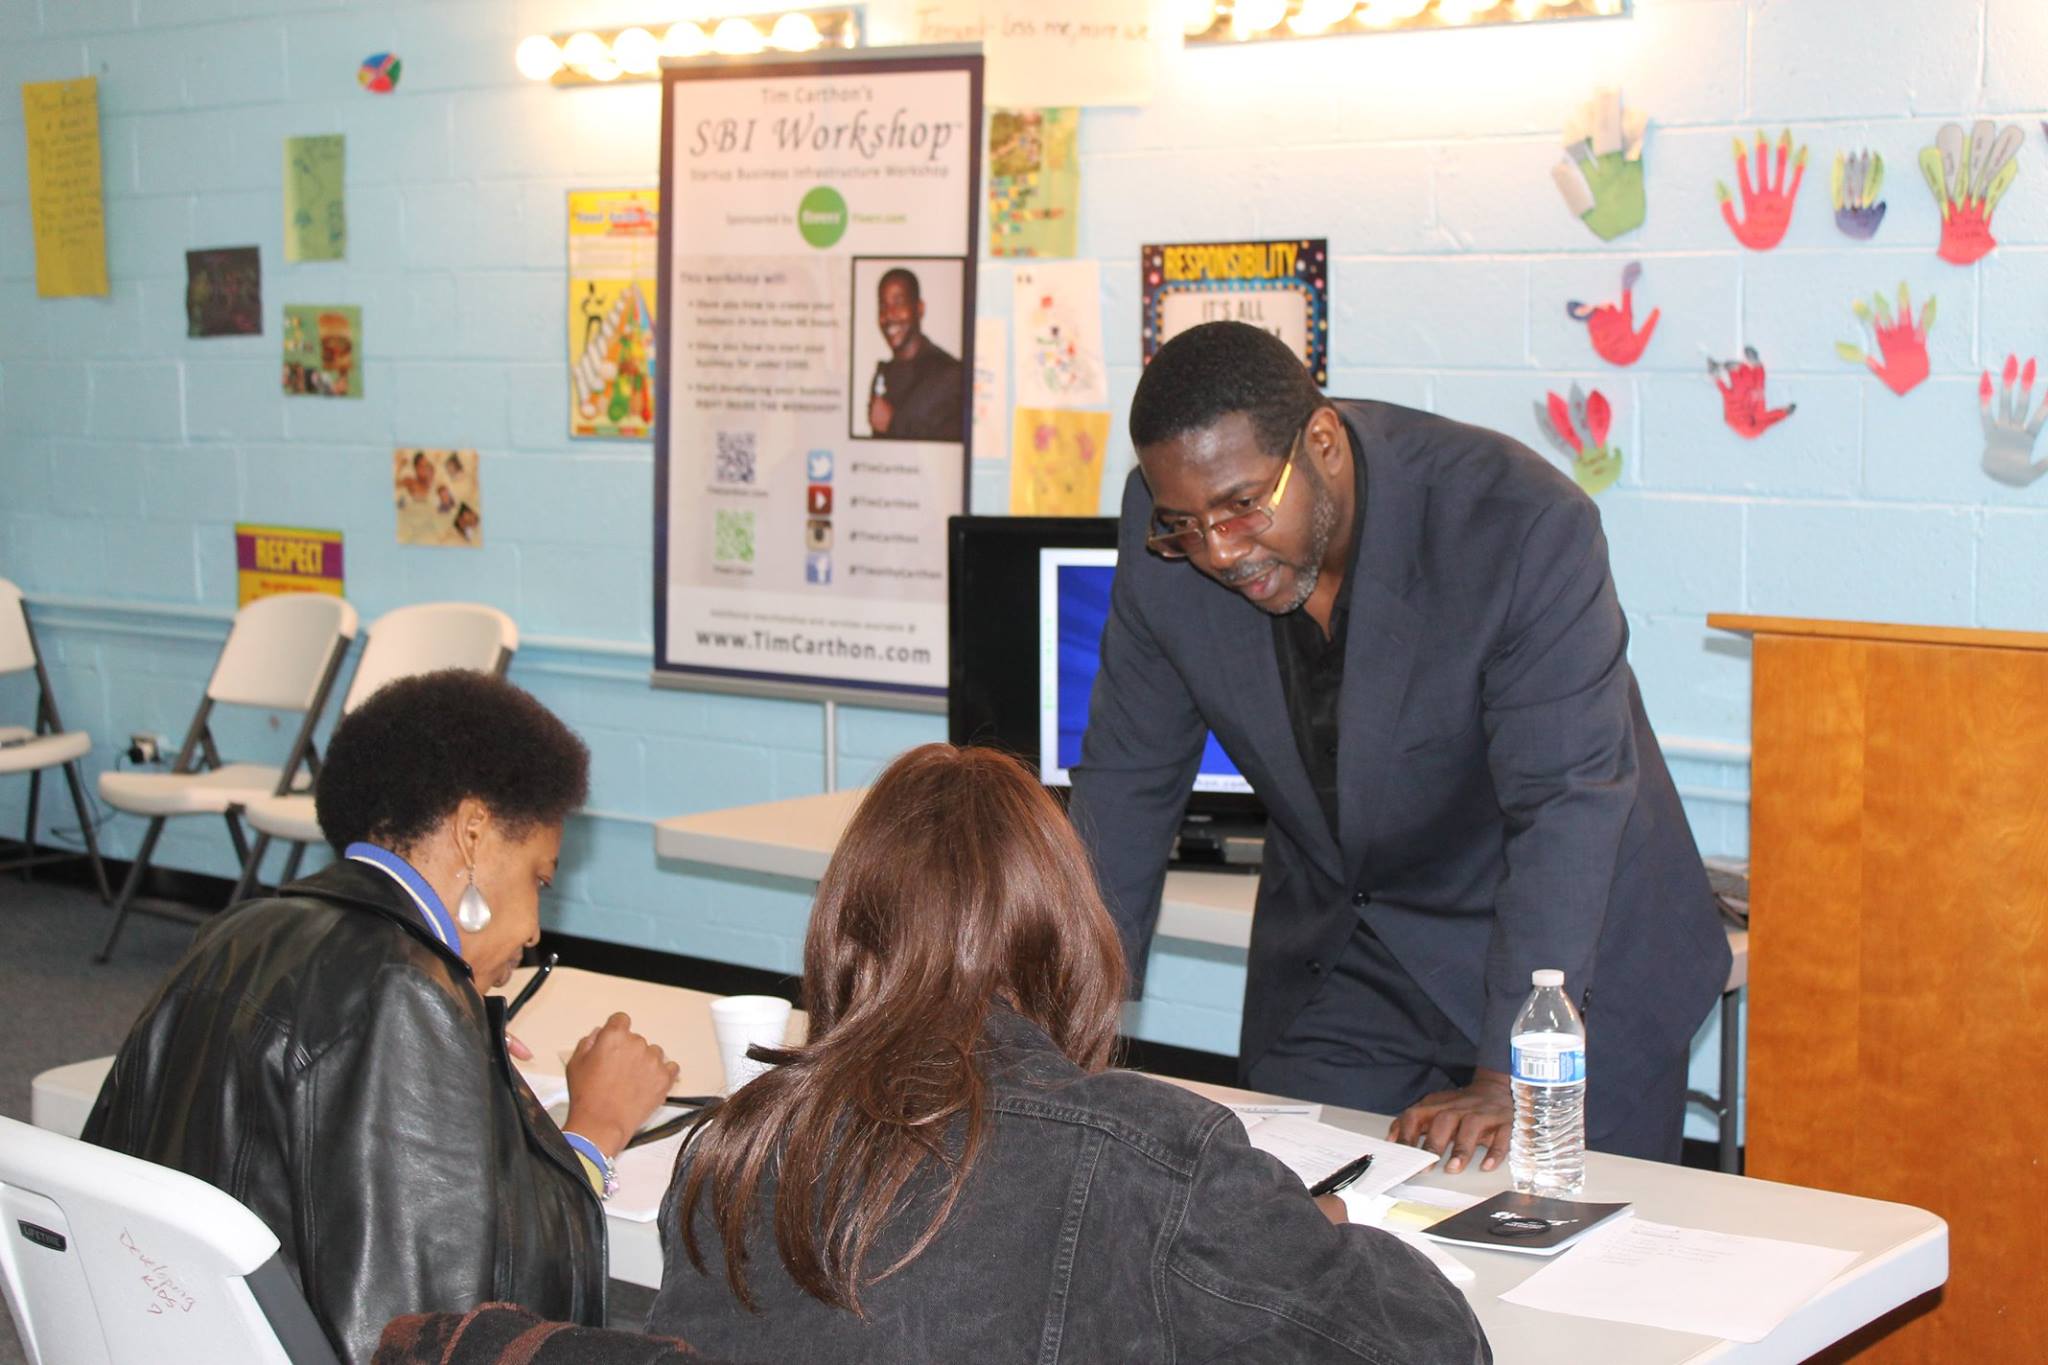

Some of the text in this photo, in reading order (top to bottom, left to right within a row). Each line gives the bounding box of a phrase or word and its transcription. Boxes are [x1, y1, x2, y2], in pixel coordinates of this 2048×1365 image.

[761, 85, 873, 104] Tim Carthon's
[689, 108, 953, 161] SBI Workshop
[737, 165, 789, 180] Business
[794, 164, 880, 179] Infrastructure
[885, 162, 949, 178] Workshop
[1163, 243, 1298, 281] RESPONSIBILITY
[706, 272, 758, 286] workshop
[1202, 300, 1264, 321] IT'S ALL
[255, 537, 323, 575] RESPECT
[695, 631, 932, 664] www.TimCarthon.com
